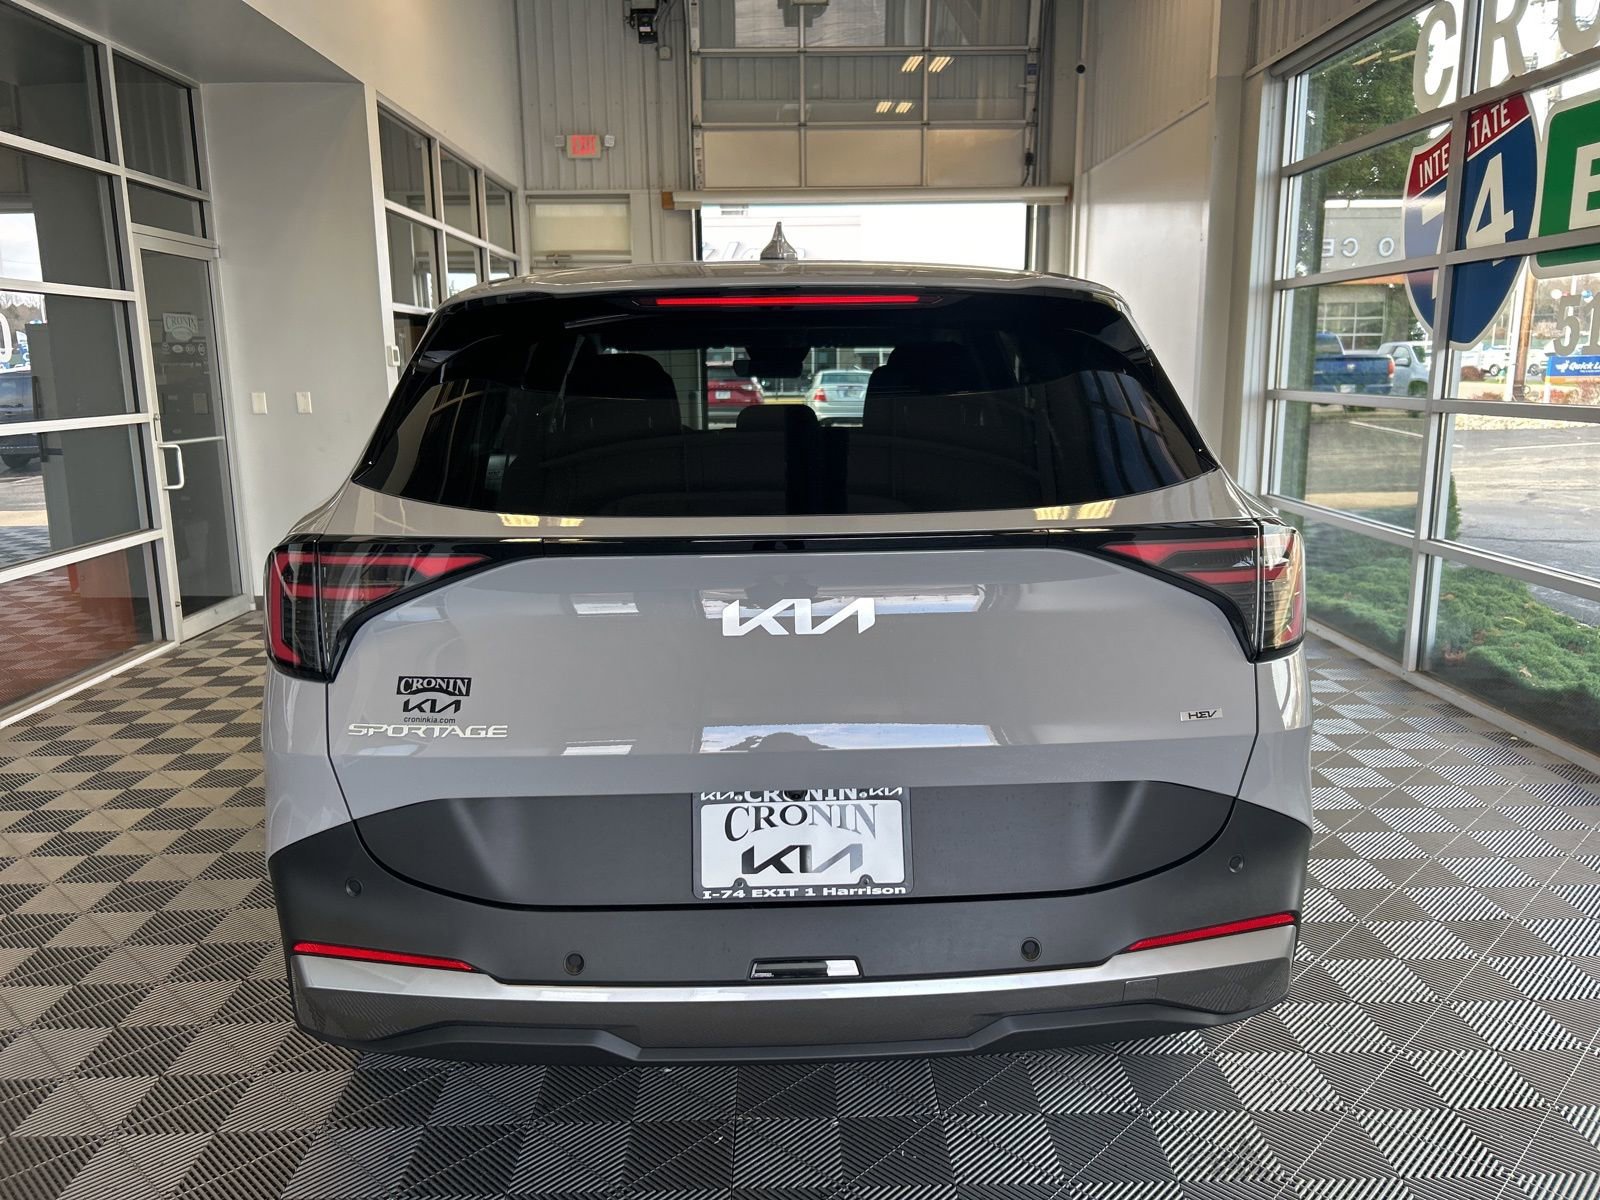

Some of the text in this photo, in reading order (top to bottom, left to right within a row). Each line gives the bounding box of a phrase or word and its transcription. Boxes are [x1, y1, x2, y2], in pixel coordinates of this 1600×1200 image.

[571, 134, 596, 155] EXIT
[1418, 99, 1511, 188] INTETATE
[1568, 362, 1592, 371] Quick
[722, 597, 876, 637] KIA
[399, 677, 469, 695] CRONIN
[403, 698, 462, 714] KIA
[403, 716, 456, 724] croninkia.com
[1188, 710, 1217, 720] HEV
[348, 723, 509, 738] SPORTAGE
[744, 788, 856, 802] CRNIN
[724, 803, 878, 842] CRONIN
[742, 843, 863, 874] KIA
[702, 886, 906, 900] I-74 EXIT 1 Harrison
